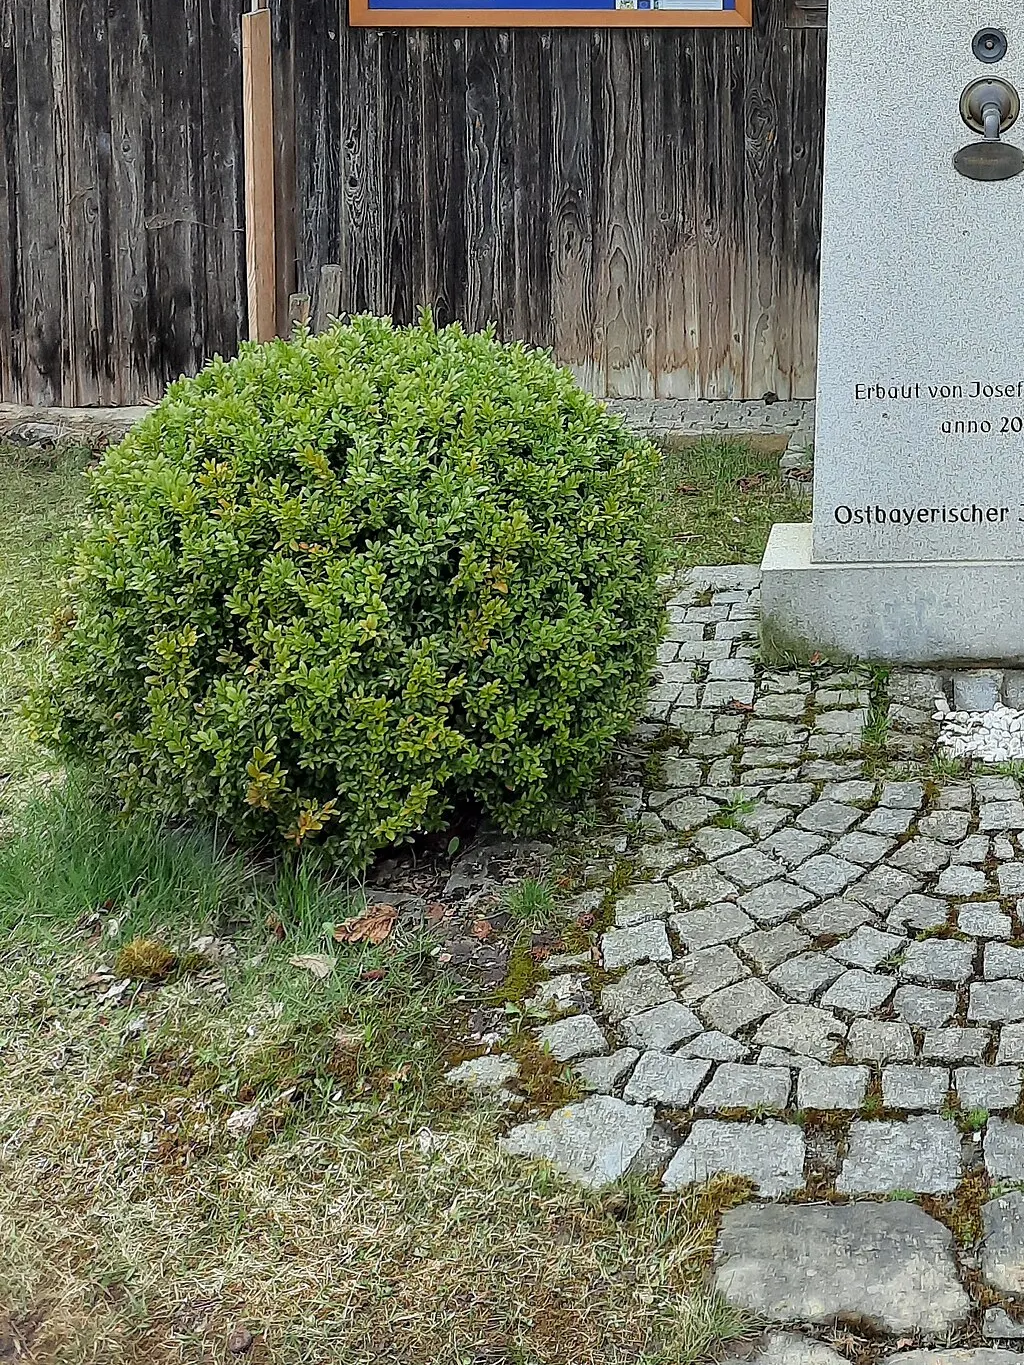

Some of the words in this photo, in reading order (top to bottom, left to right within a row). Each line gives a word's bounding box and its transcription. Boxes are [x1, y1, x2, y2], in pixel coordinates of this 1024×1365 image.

[855, 382, 920, 400] Erbaut
[928, 383, 963, 399] von
[968, 381, 1023, 398] Josef
[941, 418, 992, 434] anno
[834, 503, 1009, 526] Ostbayerischer
